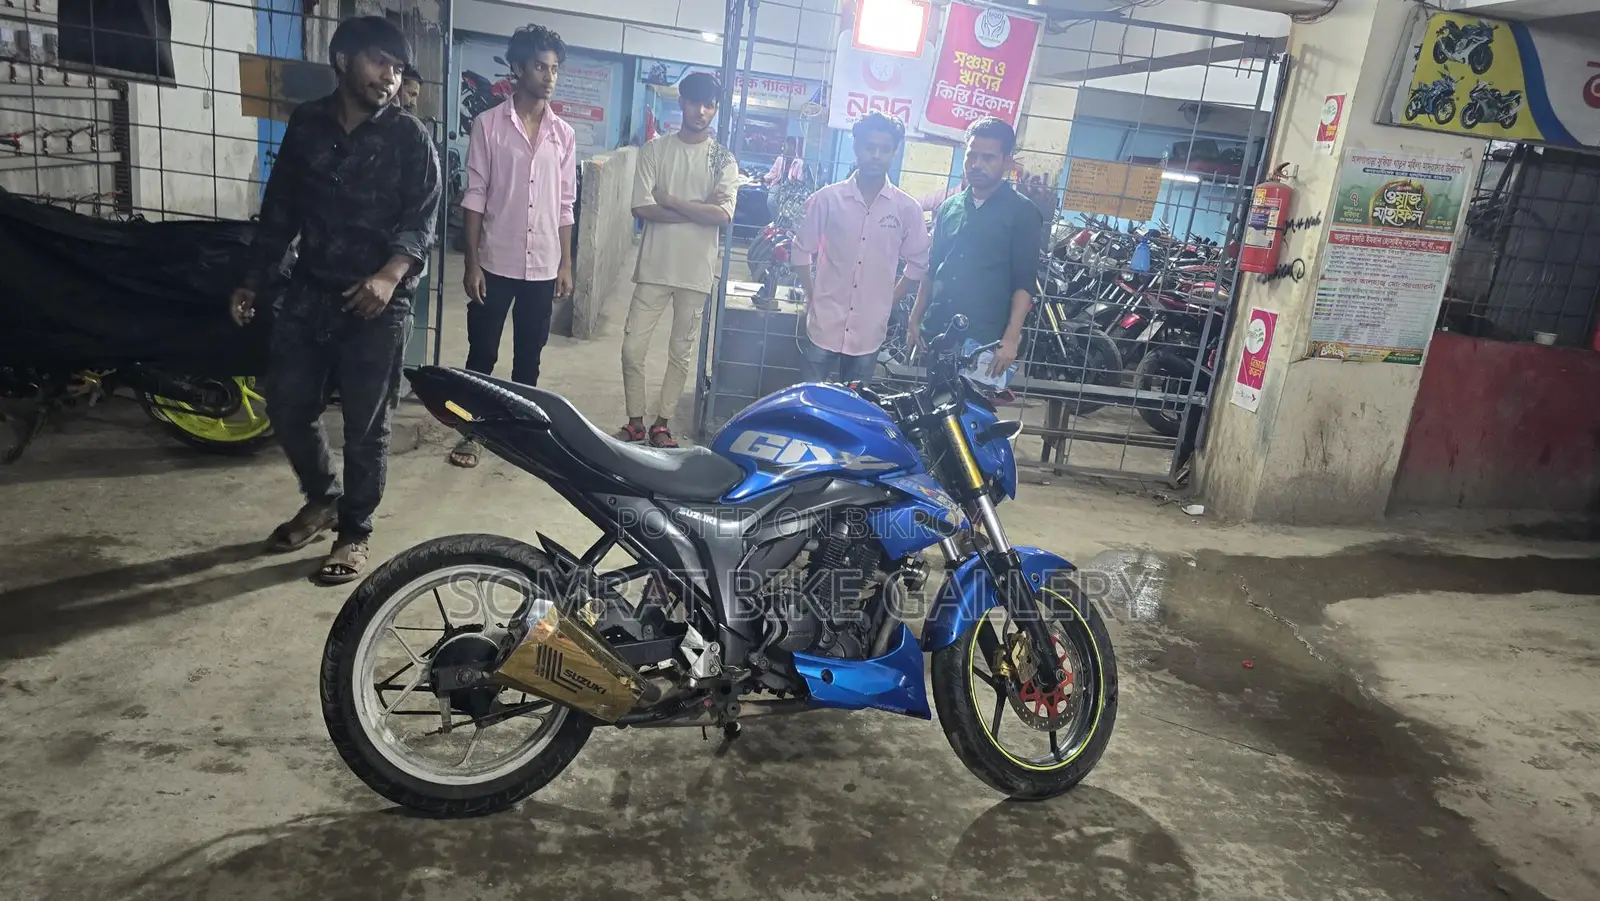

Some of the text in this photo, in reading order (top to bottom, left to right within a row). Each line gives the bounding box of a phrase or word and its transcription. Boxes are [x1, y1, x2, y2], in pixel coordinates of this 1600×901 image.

[953, 51, 1006, 76] সঞ্চয় ও
[959, 69, 1003, 92] ঋণের
[935, 80, 1016, 114] কিস্তি বিকাশ
[679, 507, 717, 526] SUZUKI
[564, 669, 607, 694] SUZUKI
